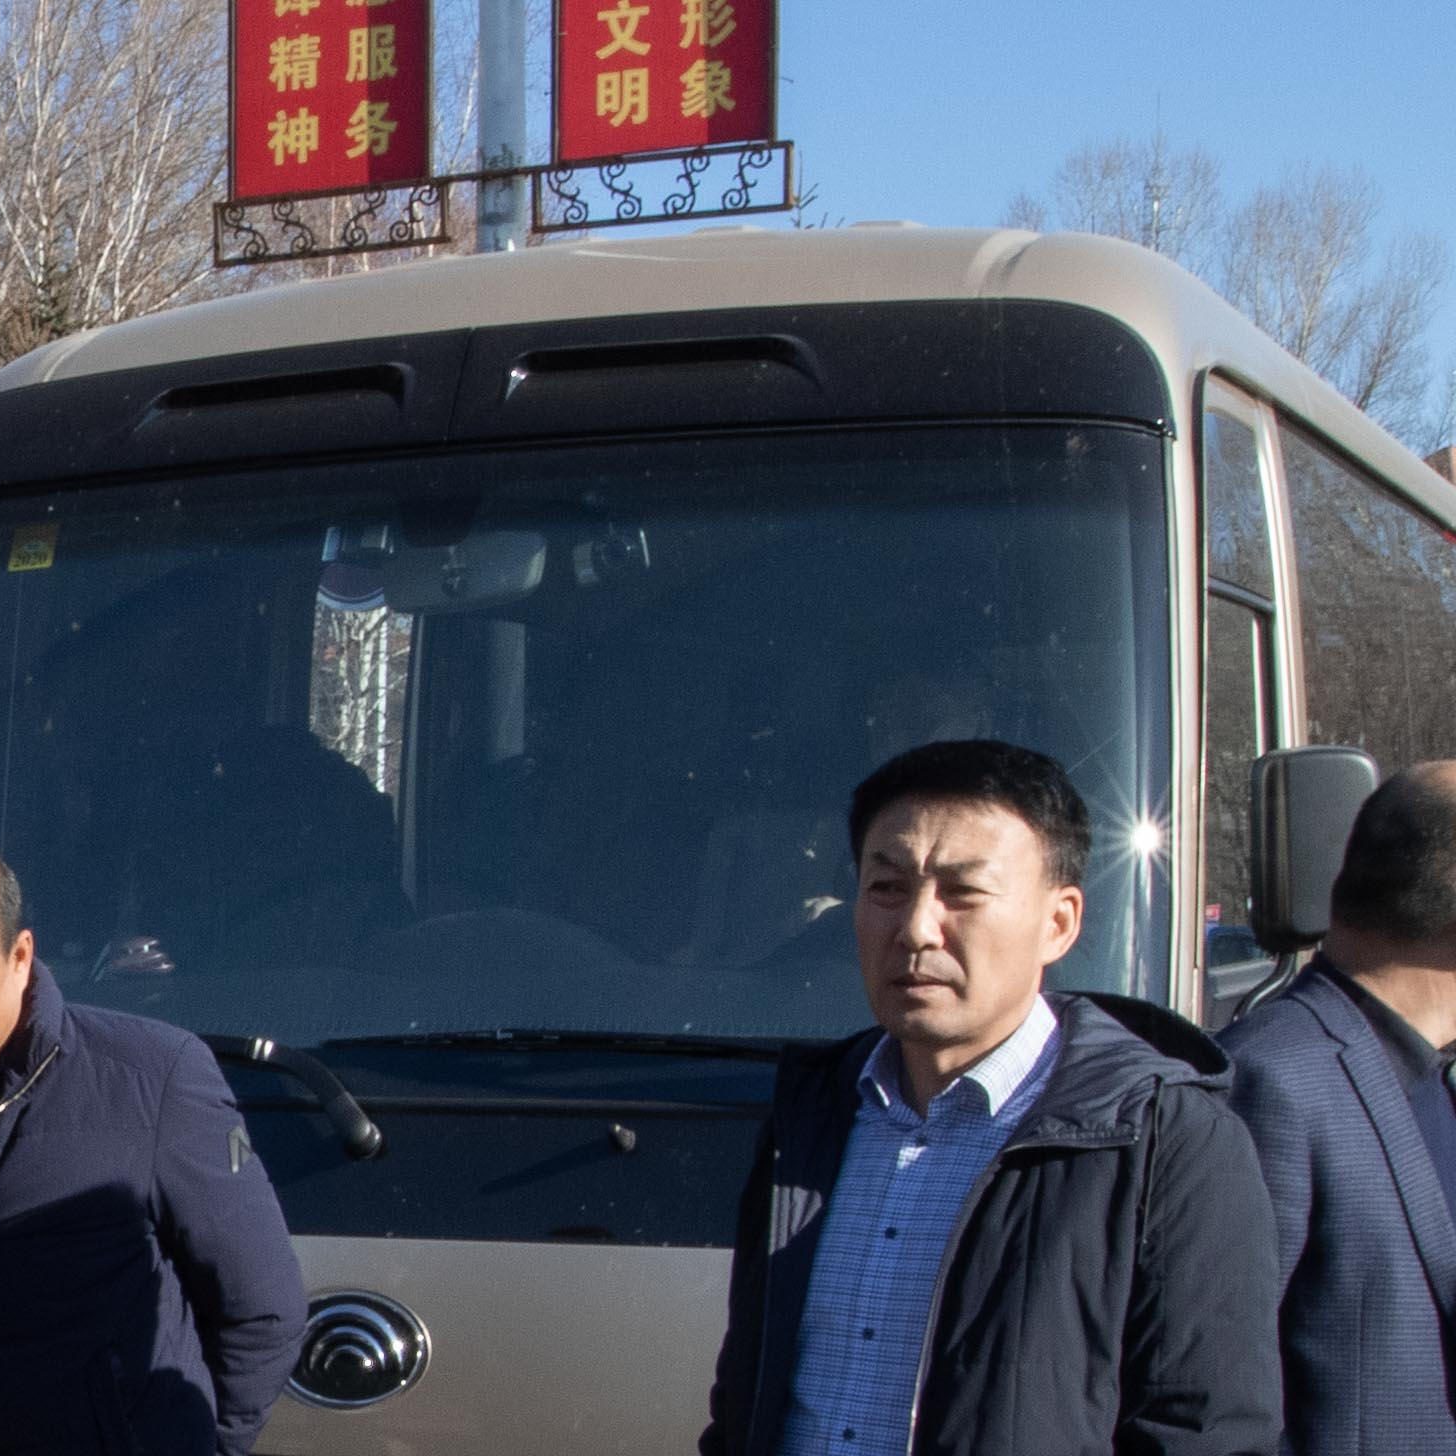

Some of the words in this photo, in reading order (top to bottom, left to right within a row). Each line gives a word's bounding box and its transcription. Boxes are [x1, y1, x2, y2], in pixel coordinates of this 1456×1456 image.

[345, 0, 398, 160] 服务
[595, 0, 652, 128] 文明
[679, 0, 737, 119] 形象
